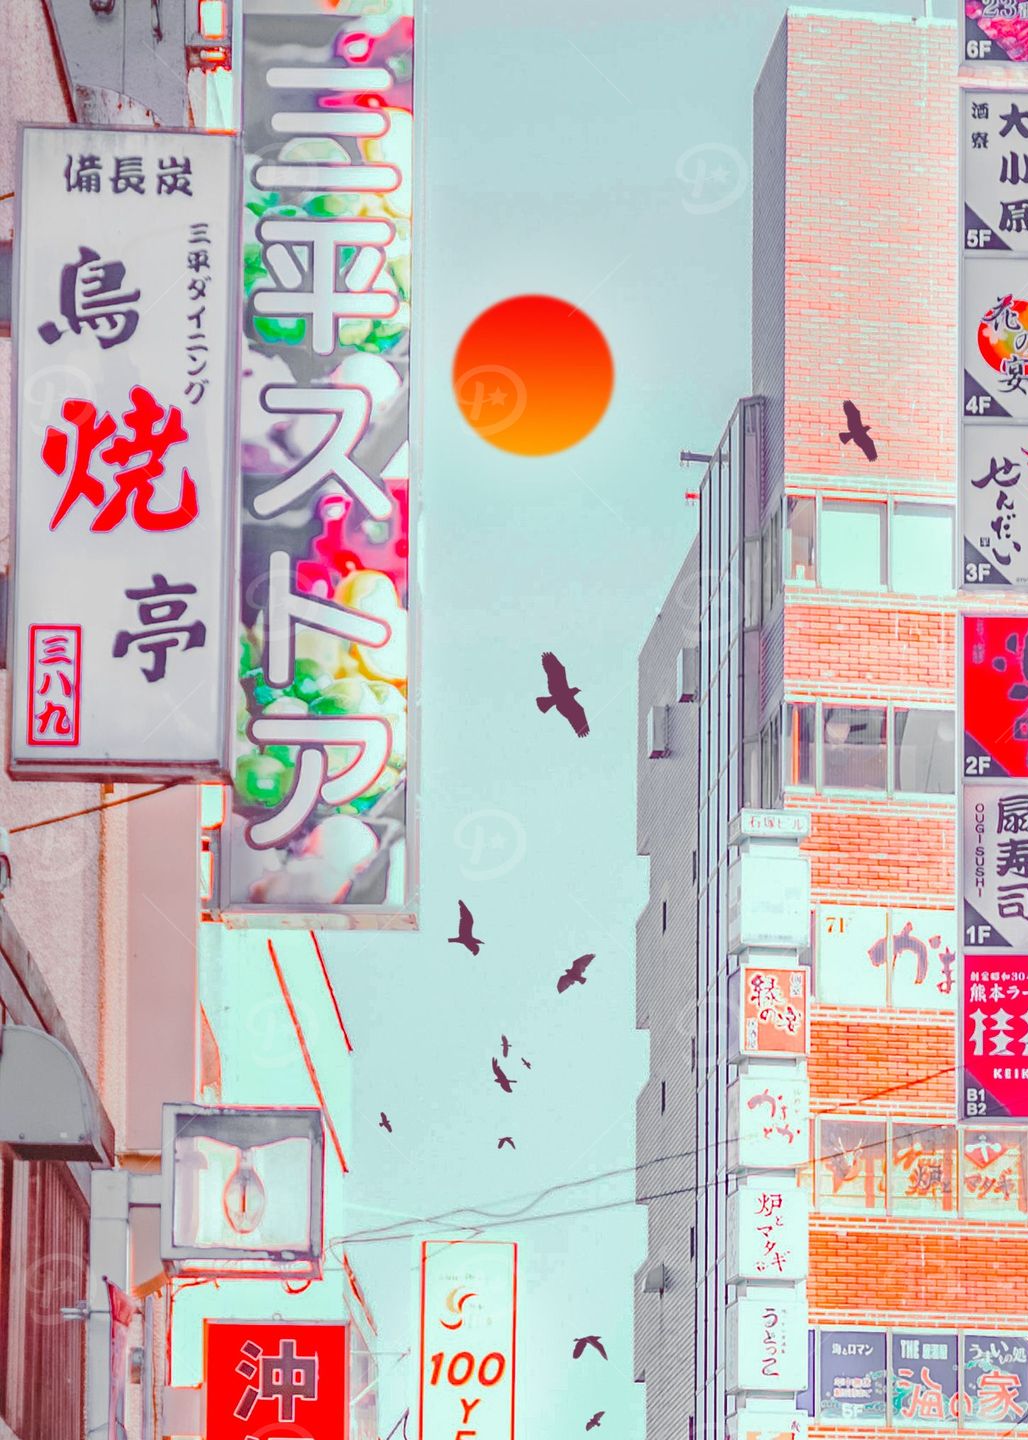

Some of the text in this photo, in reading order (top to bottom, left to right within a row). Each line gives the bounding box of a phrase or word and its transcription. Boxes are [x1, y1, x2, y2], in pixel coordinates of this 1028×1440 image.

[966, 40, 992, 59] 6F
[64, 154, 194, 197] 備長炭
[966, 229, 991, 248] 5F
[185, 222, 212, 405] 三平ダイニング
[965, 396, 991, 415] 4F
[250, 65, 403, 850] 三平ストア
[970, 456, 1022, 566] せんだい
[965, 564, 991, 582] 3F
[38, 636, 71, 735] 三八九
[966, 757, 992, 775] 2F
[966, 925, 991, 944] 1F
[967, 1088, 986, 1102] B1
[967, 1103, 987, 1116] B2
[429, 1351, 506, 1387] 100
